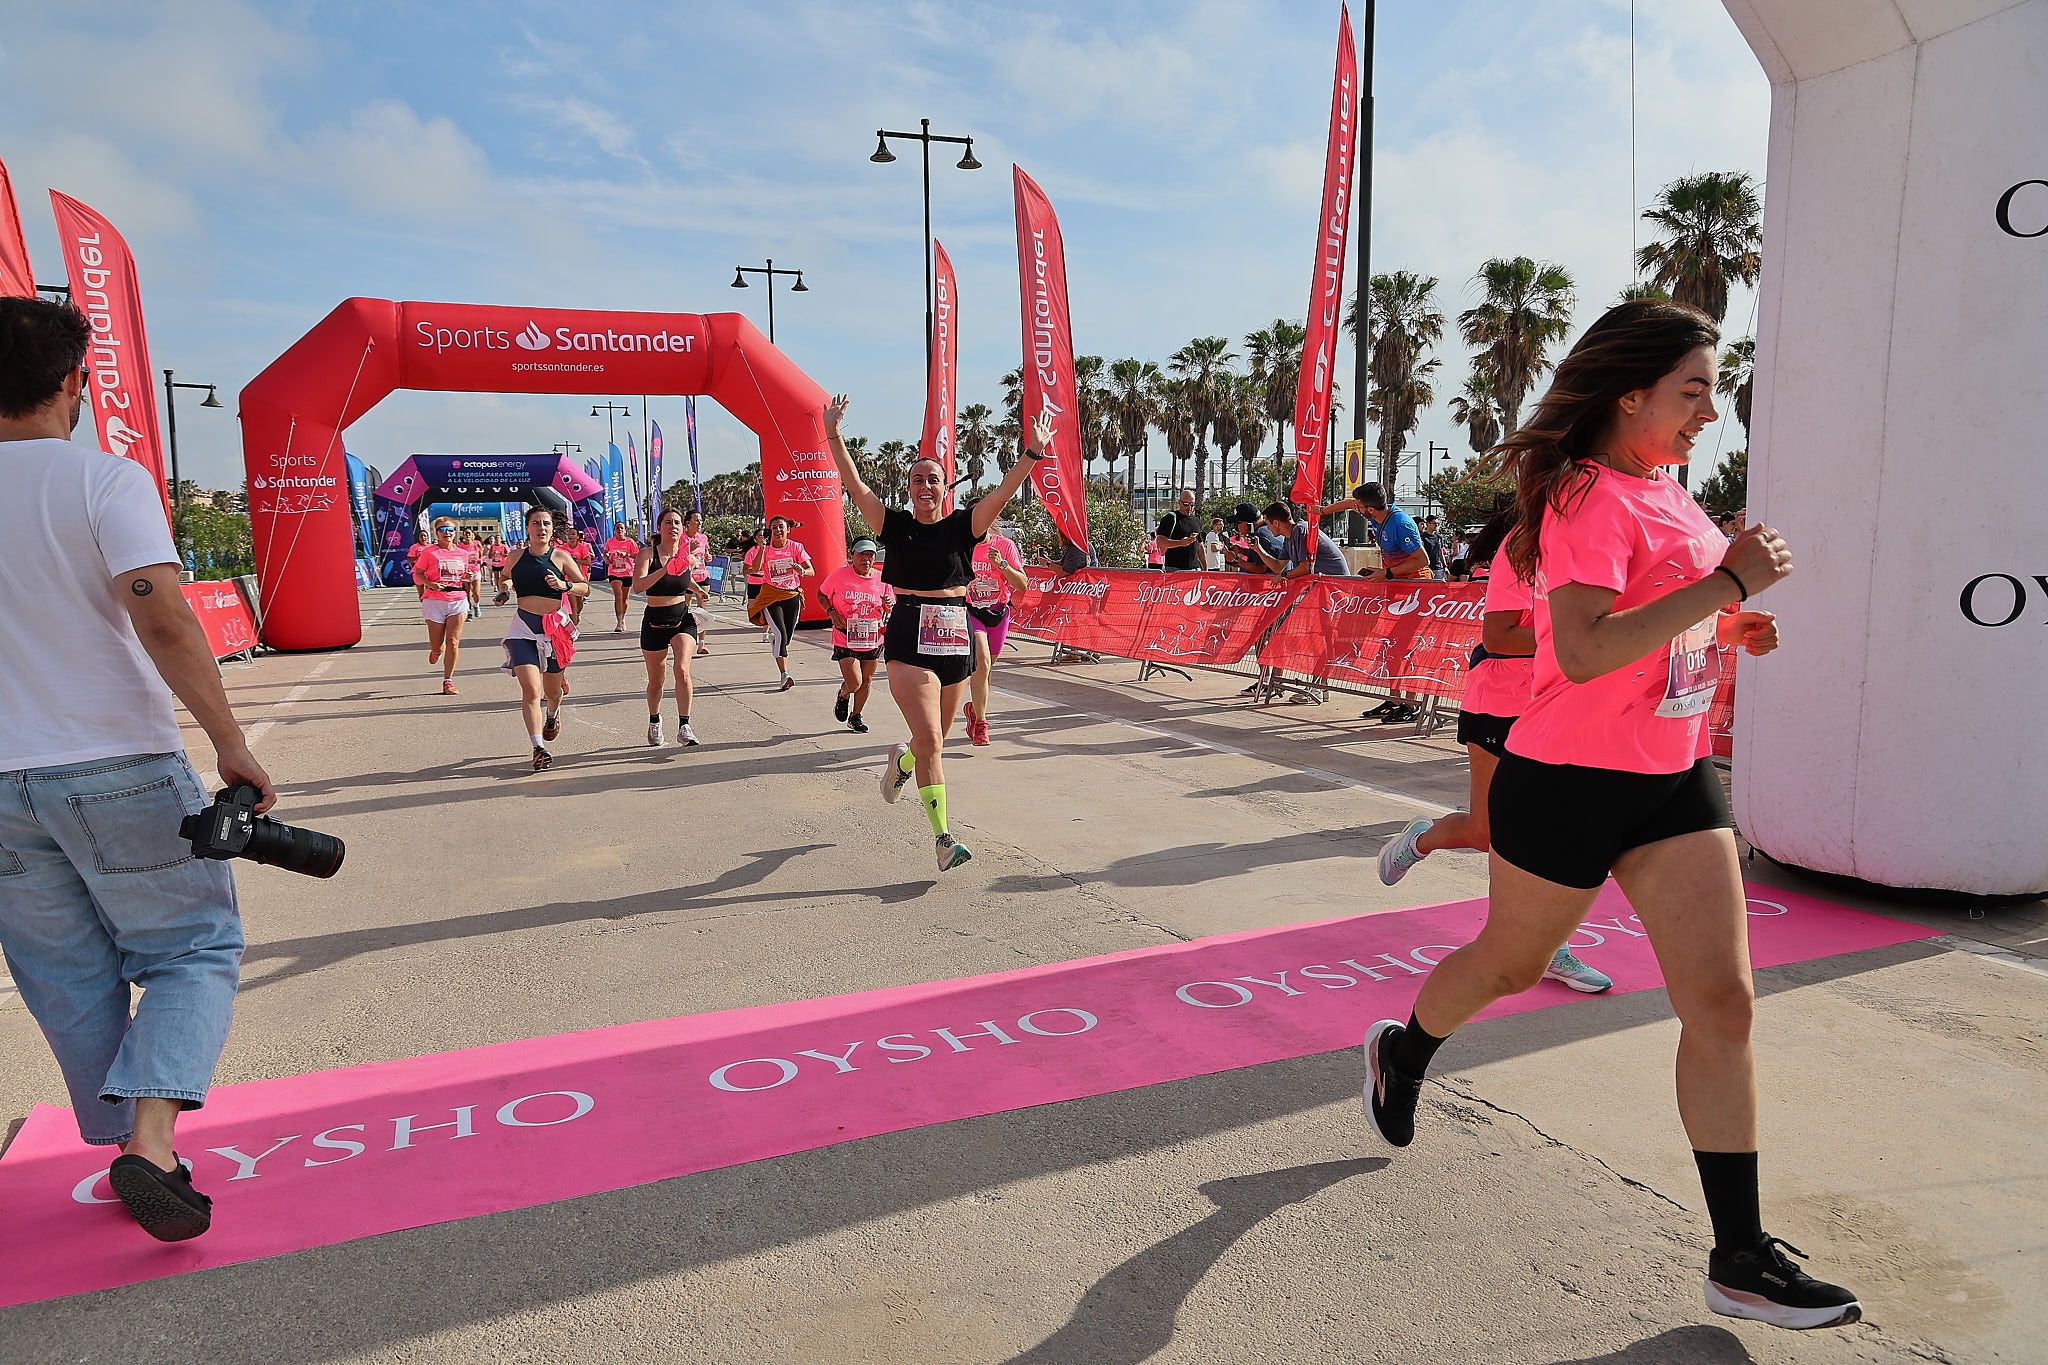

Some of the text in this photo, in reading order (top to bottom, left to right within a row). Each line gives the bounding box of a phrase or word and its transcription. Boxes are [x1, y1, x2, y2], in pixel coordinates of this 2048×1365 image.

[416, 321, 695, 354] Sports Santander
[511, 361, 605, 374] sportssantander.es
[269, 454, 317, 469] Sports
[463, 461, 526, 470] octopus energy
[792, 450, 827, 463] Sports
[268, 475, 337, 488] Santander
[790, 468, 839, 480] Santander
[1054, 577, 1111, 599] Santander
[1133, 581, 1288, 608] Sports Santander
[1321, 589, 1391, 622] Sports
[1687, 648, 1707, 672] 016
[708, 1008, 1098, 1092] OYSHO
